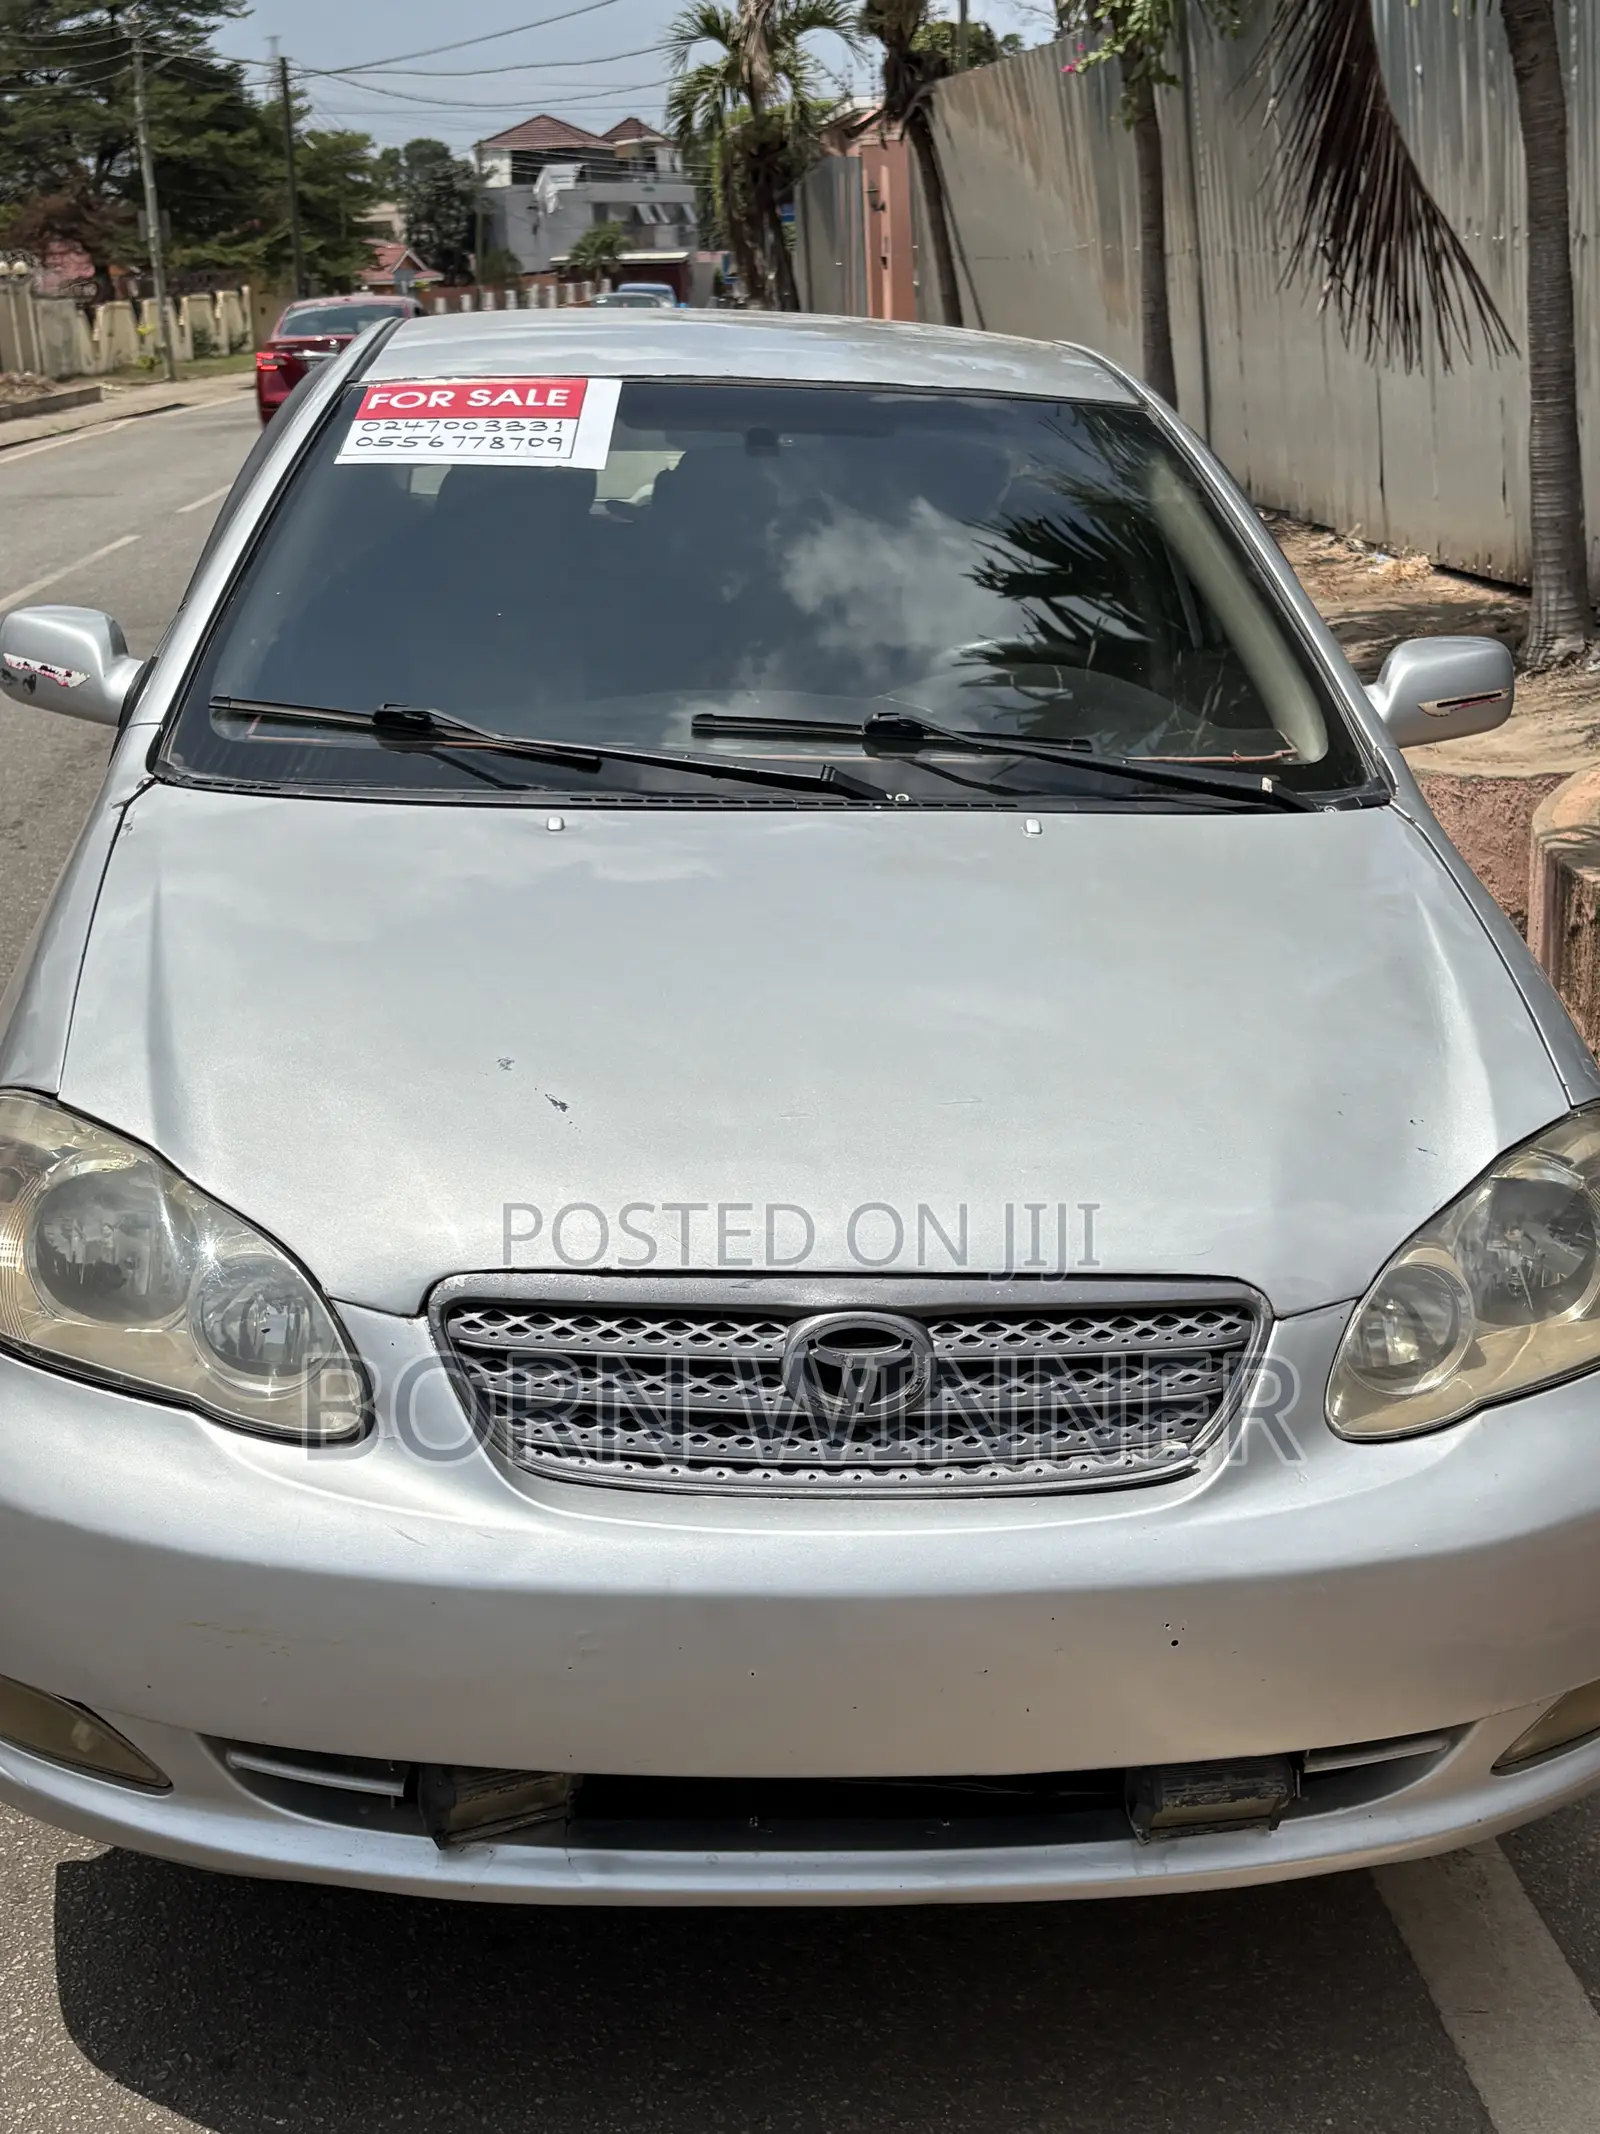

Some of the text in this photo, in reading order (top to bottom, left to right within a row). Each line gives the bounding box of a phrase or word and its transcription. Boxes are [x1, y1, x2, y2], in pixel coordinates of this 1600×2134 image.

[367, 388, 571, 410] FOR SALE
[361, 420, 563, 433] 0247003331
[355, 435, 563, 452] 0556778709
